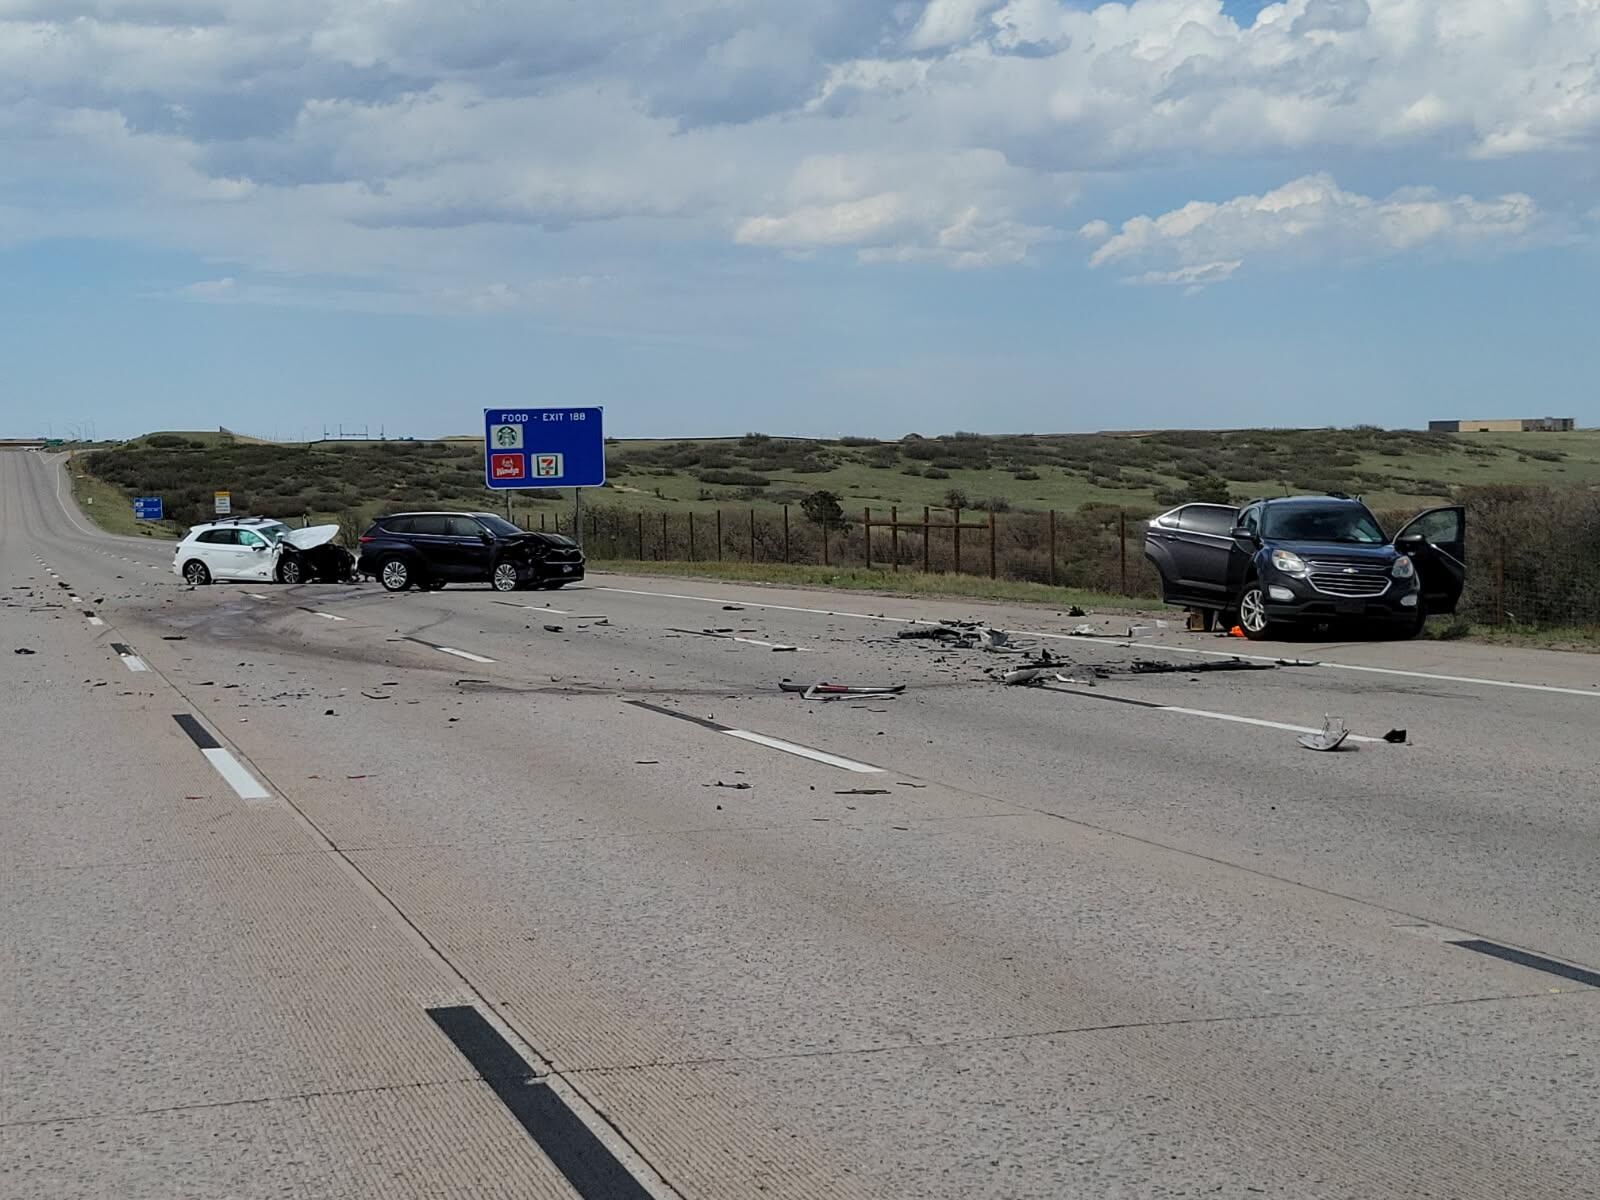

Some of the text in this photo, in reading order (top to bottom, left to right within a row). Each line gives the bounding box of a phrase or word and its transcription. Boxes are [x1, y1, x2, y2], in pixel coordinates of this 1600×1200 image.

[501, 413, 529, 422] FOOD
[542, 412, 564, 421] EXIT
[569, 412, 586, 421] 188
